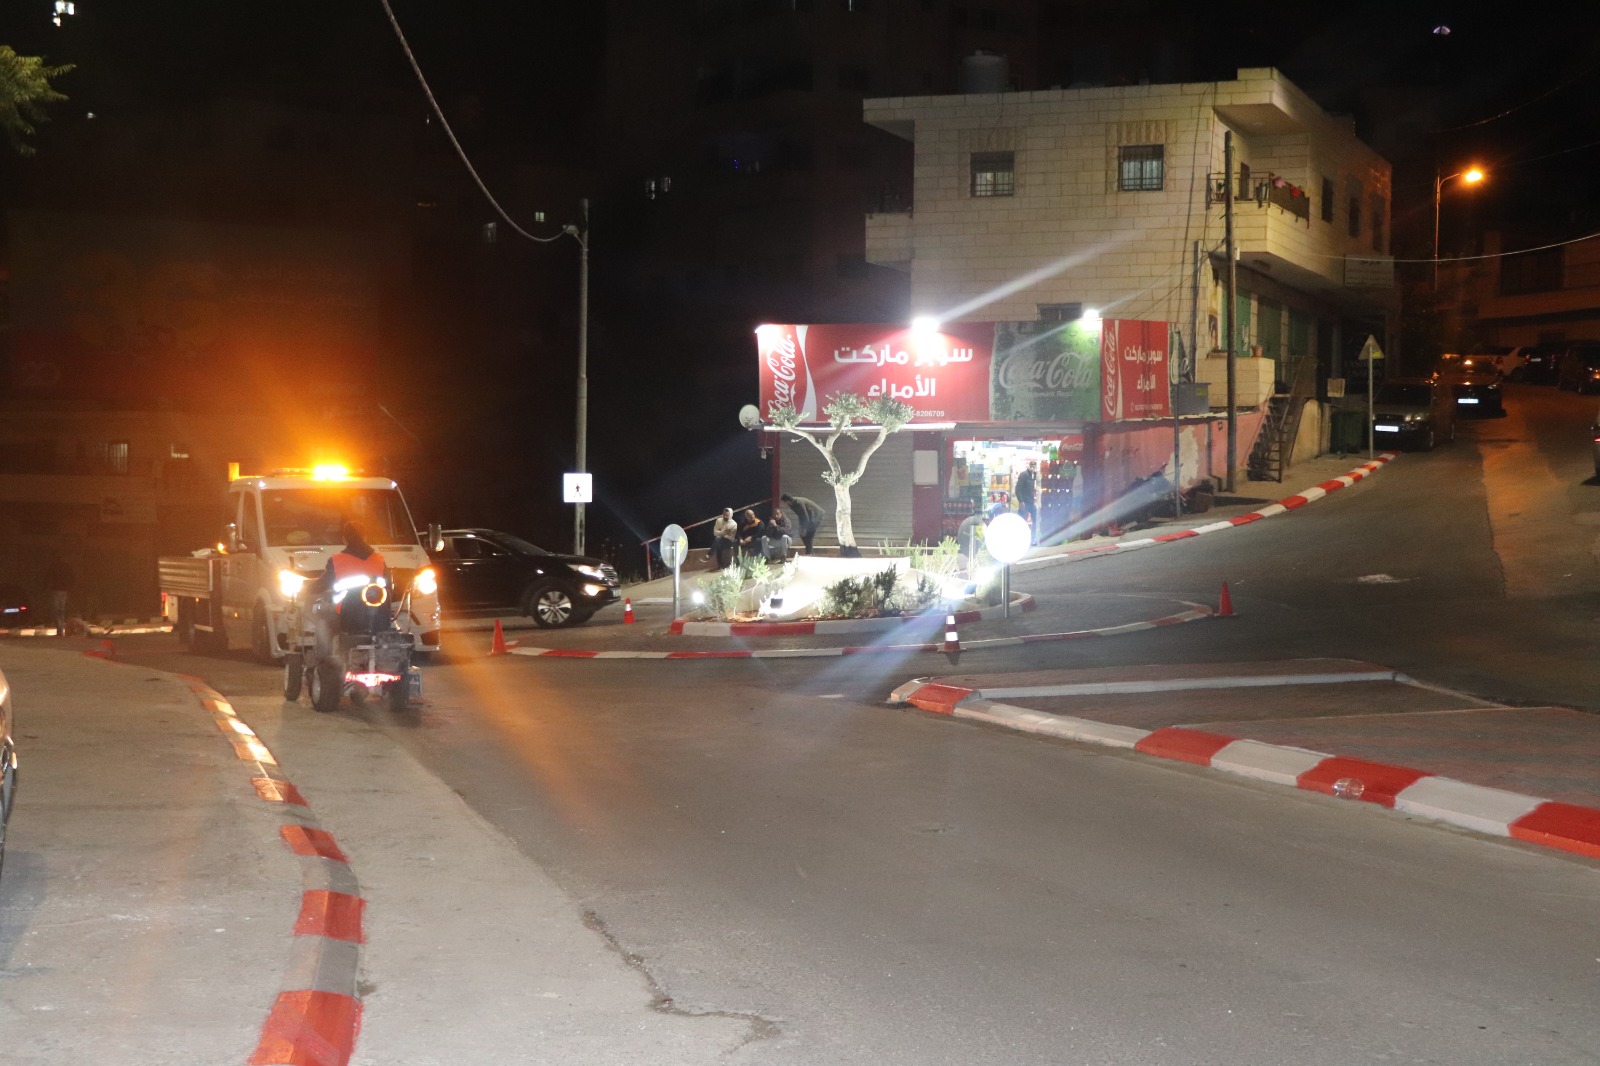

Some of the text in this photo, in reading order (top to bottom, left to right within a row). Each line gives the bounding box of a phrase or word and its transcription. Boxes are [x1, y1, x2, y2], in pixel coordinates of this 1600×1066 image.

[833, 344, 909, 367] ماركت
[1124, 345, 1146, 364] ماركت
[999, 351, 1093, 390] Coca-Cola
[867, 374, 936, 399] الأمراء
